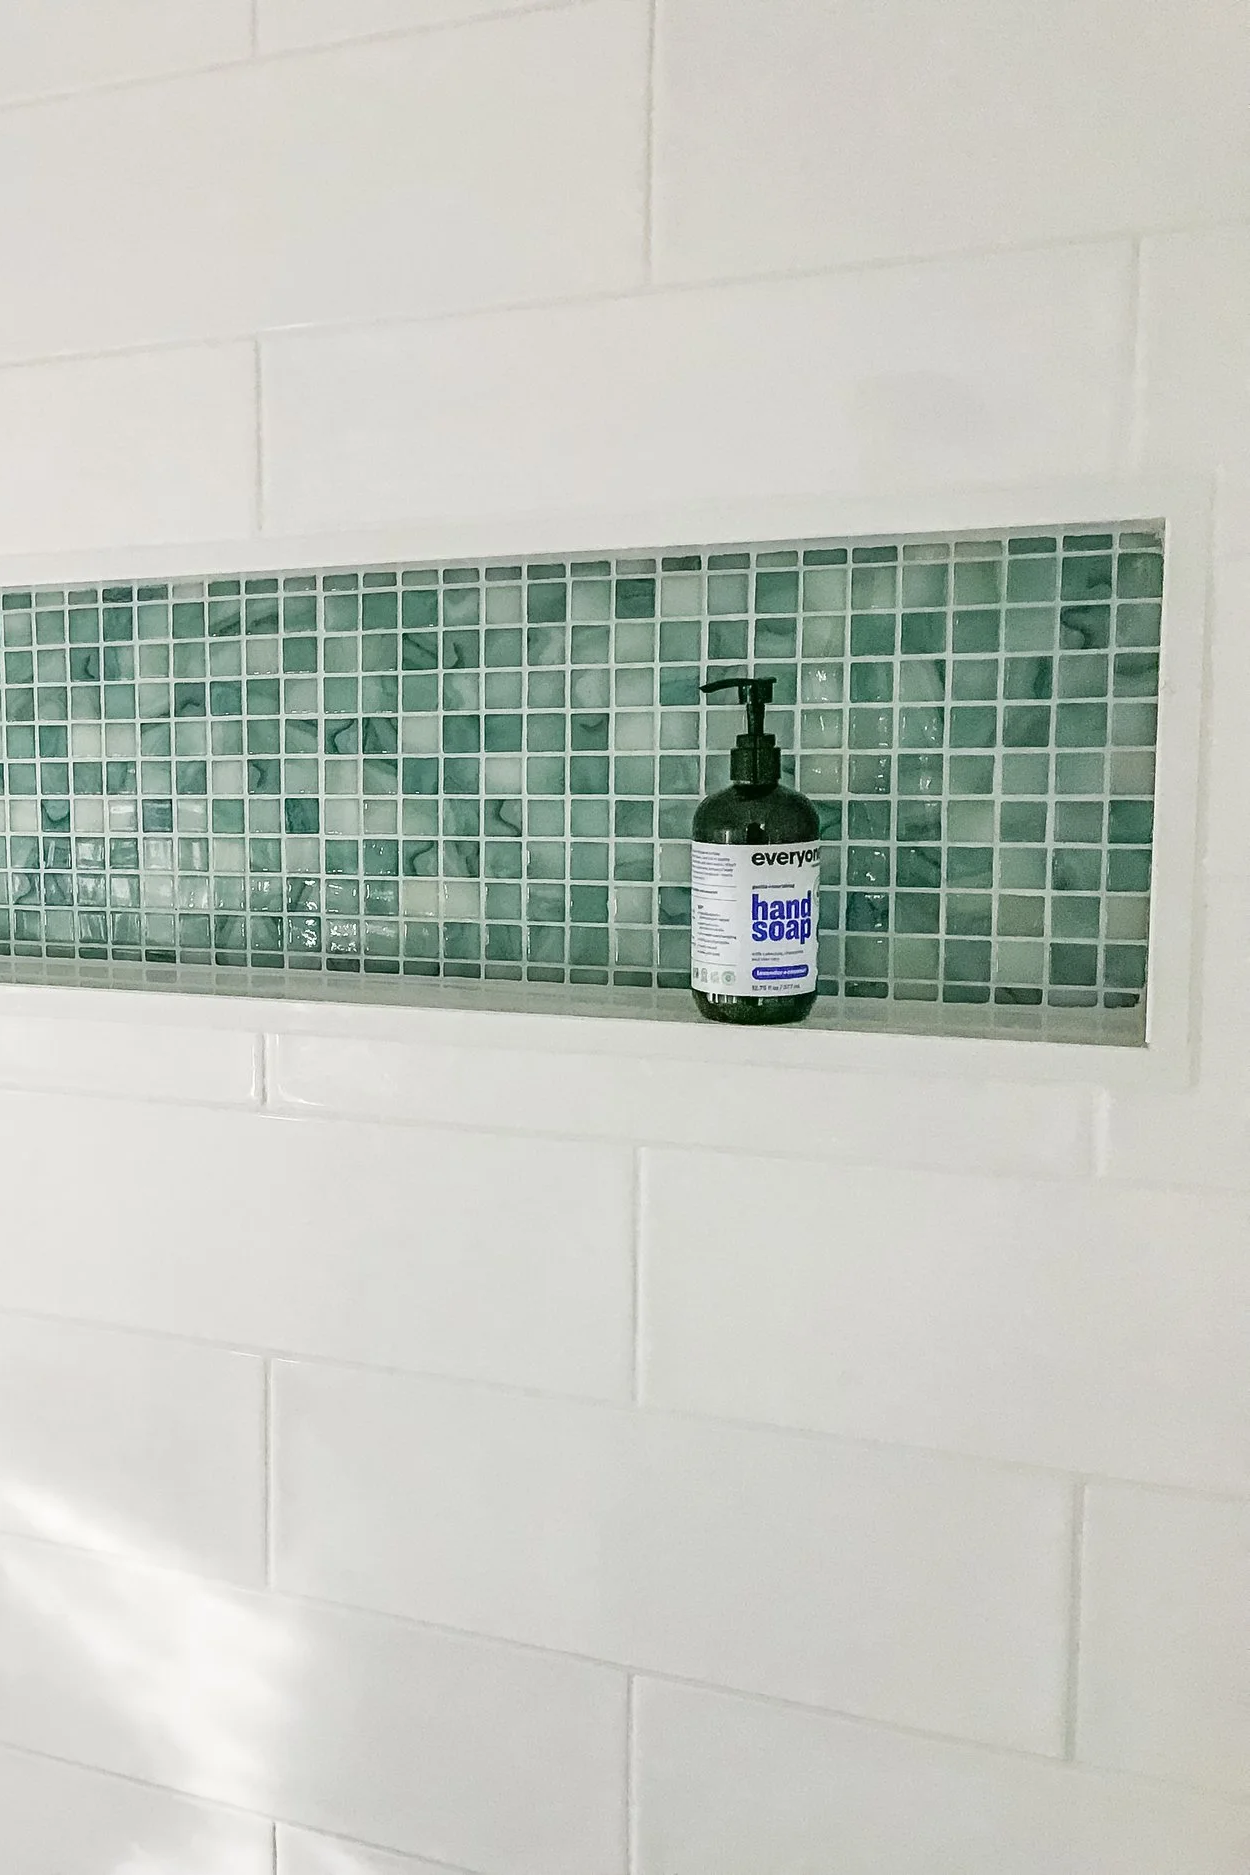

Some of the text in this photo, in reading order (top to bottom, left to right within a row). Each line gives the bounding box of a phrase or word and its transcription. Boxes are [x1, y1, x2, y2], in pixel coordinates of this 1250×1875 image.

[751, 847, 820, 868] everyon
[752, 889, 812, 920] hand
[752, 918, 812, 945] soap
